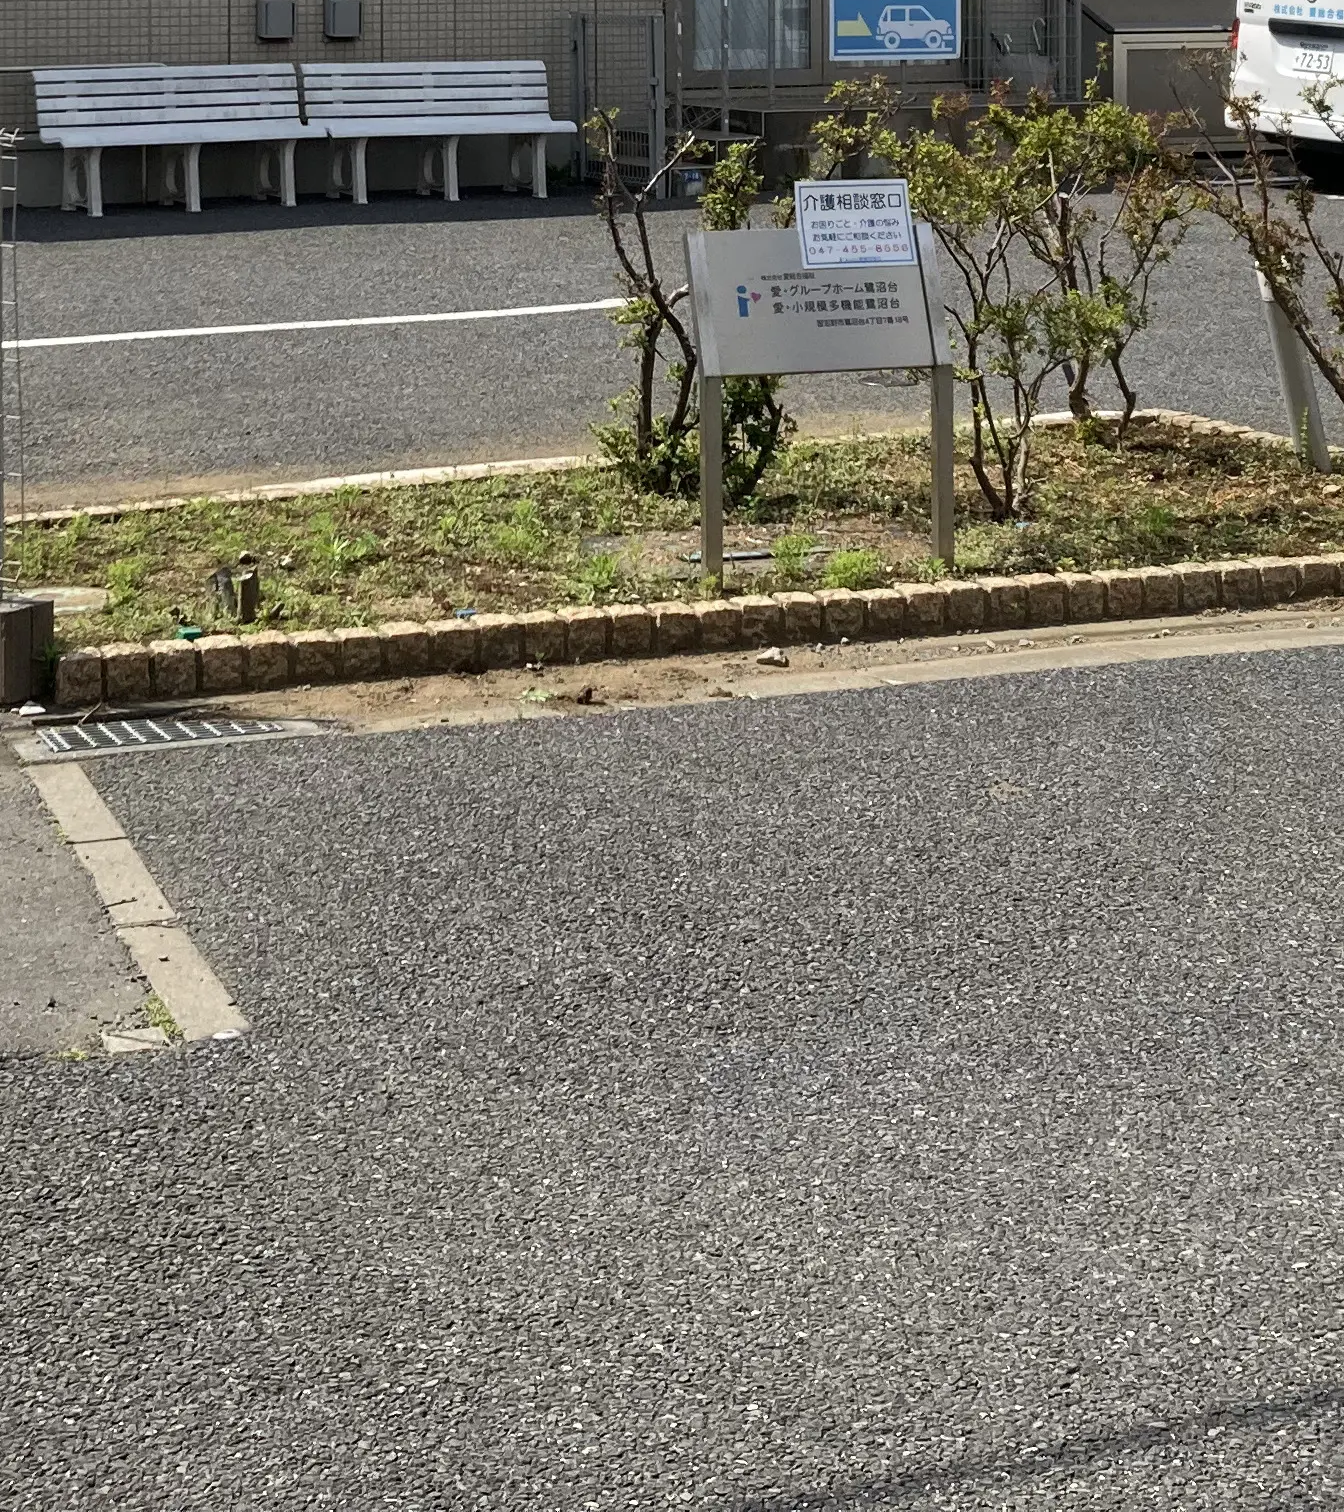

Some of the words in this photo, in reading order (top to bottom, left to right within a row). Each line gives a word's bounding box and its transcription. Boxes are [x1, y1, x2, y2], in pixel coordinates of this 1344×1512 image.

[1300, 52, 1330, 69] 72-53
[803, 192, 902, 212] 介護相談窓口
